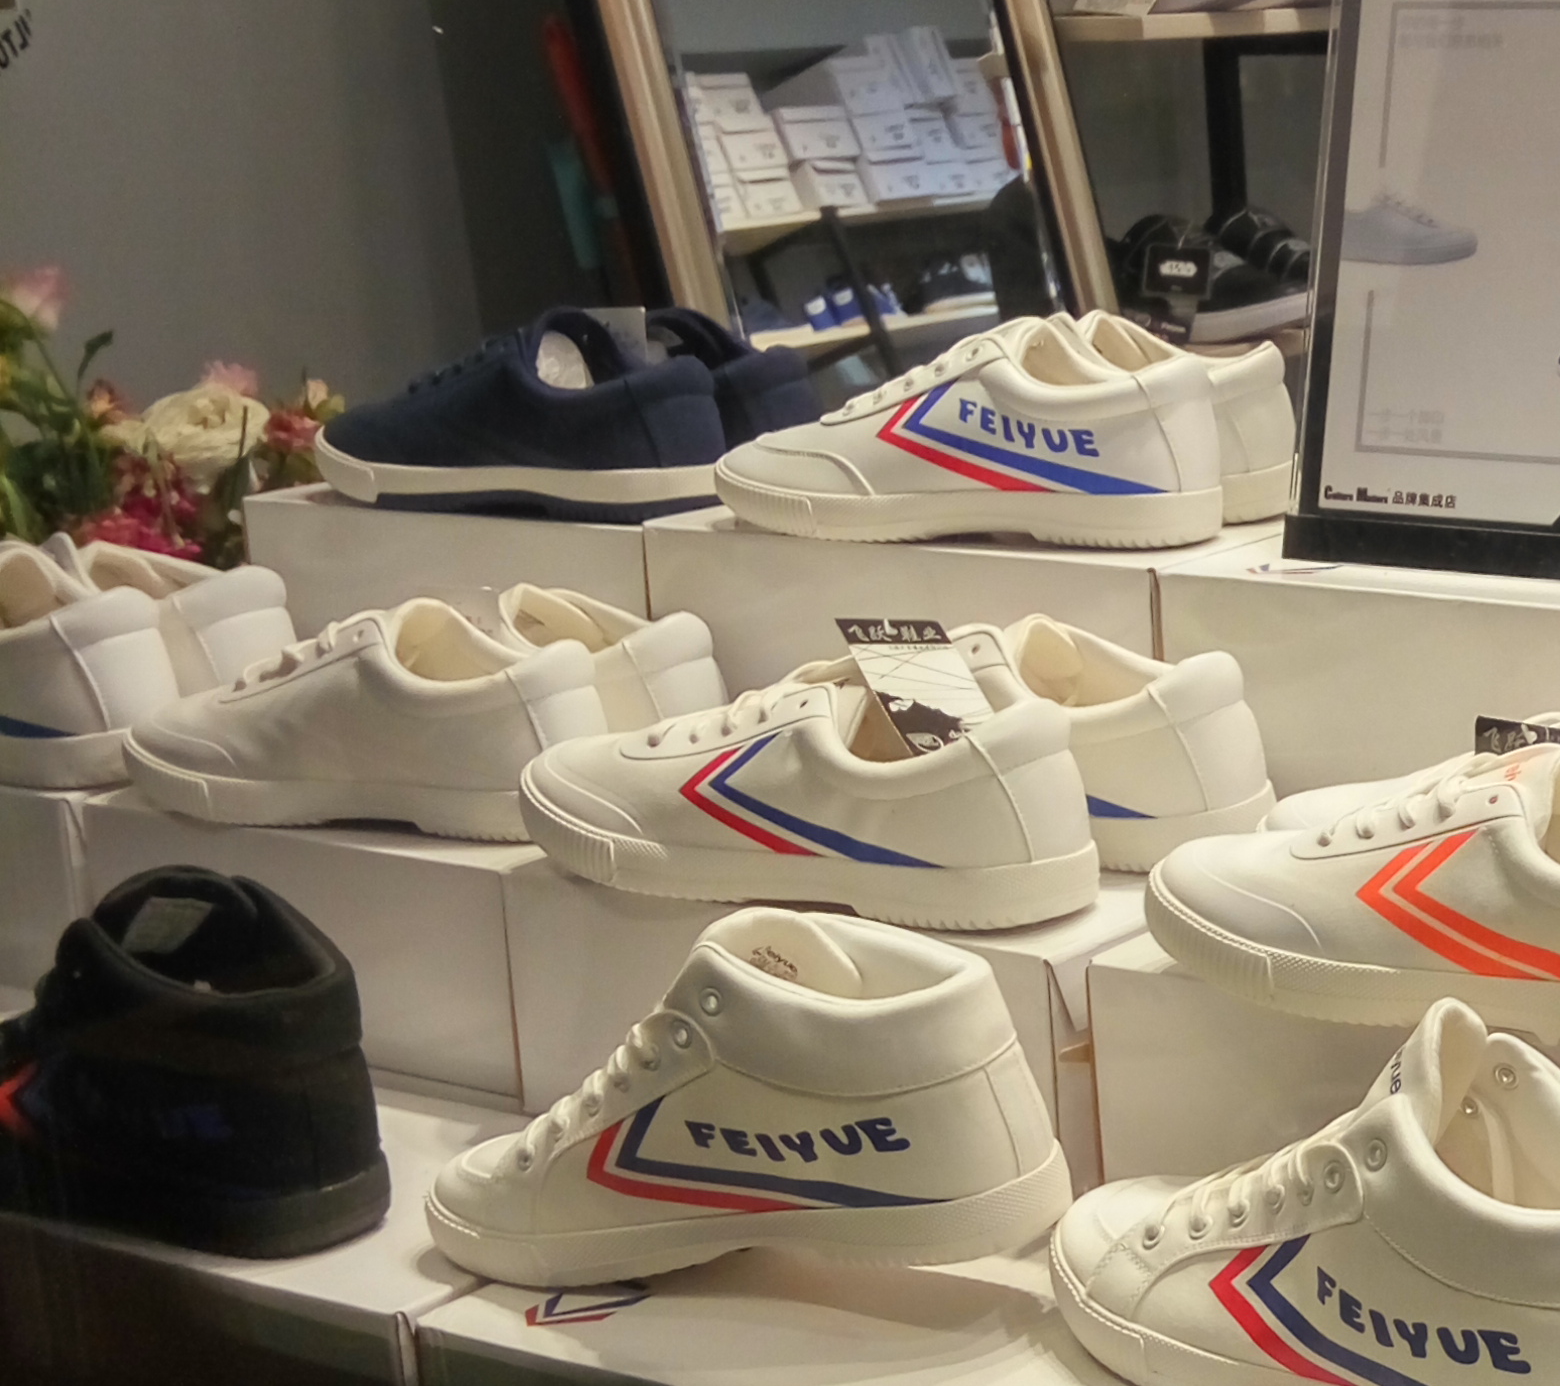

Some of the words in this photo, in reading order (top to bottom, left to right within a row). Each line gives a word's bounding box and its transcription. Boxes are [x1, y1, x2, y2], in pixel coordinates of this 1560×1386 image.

[959, 397, 1101, 457] FEIYUE
[684, 1116, 911, 1164] FEIYUE
[1315, 1265, 1533, 1376] FEIYUE
